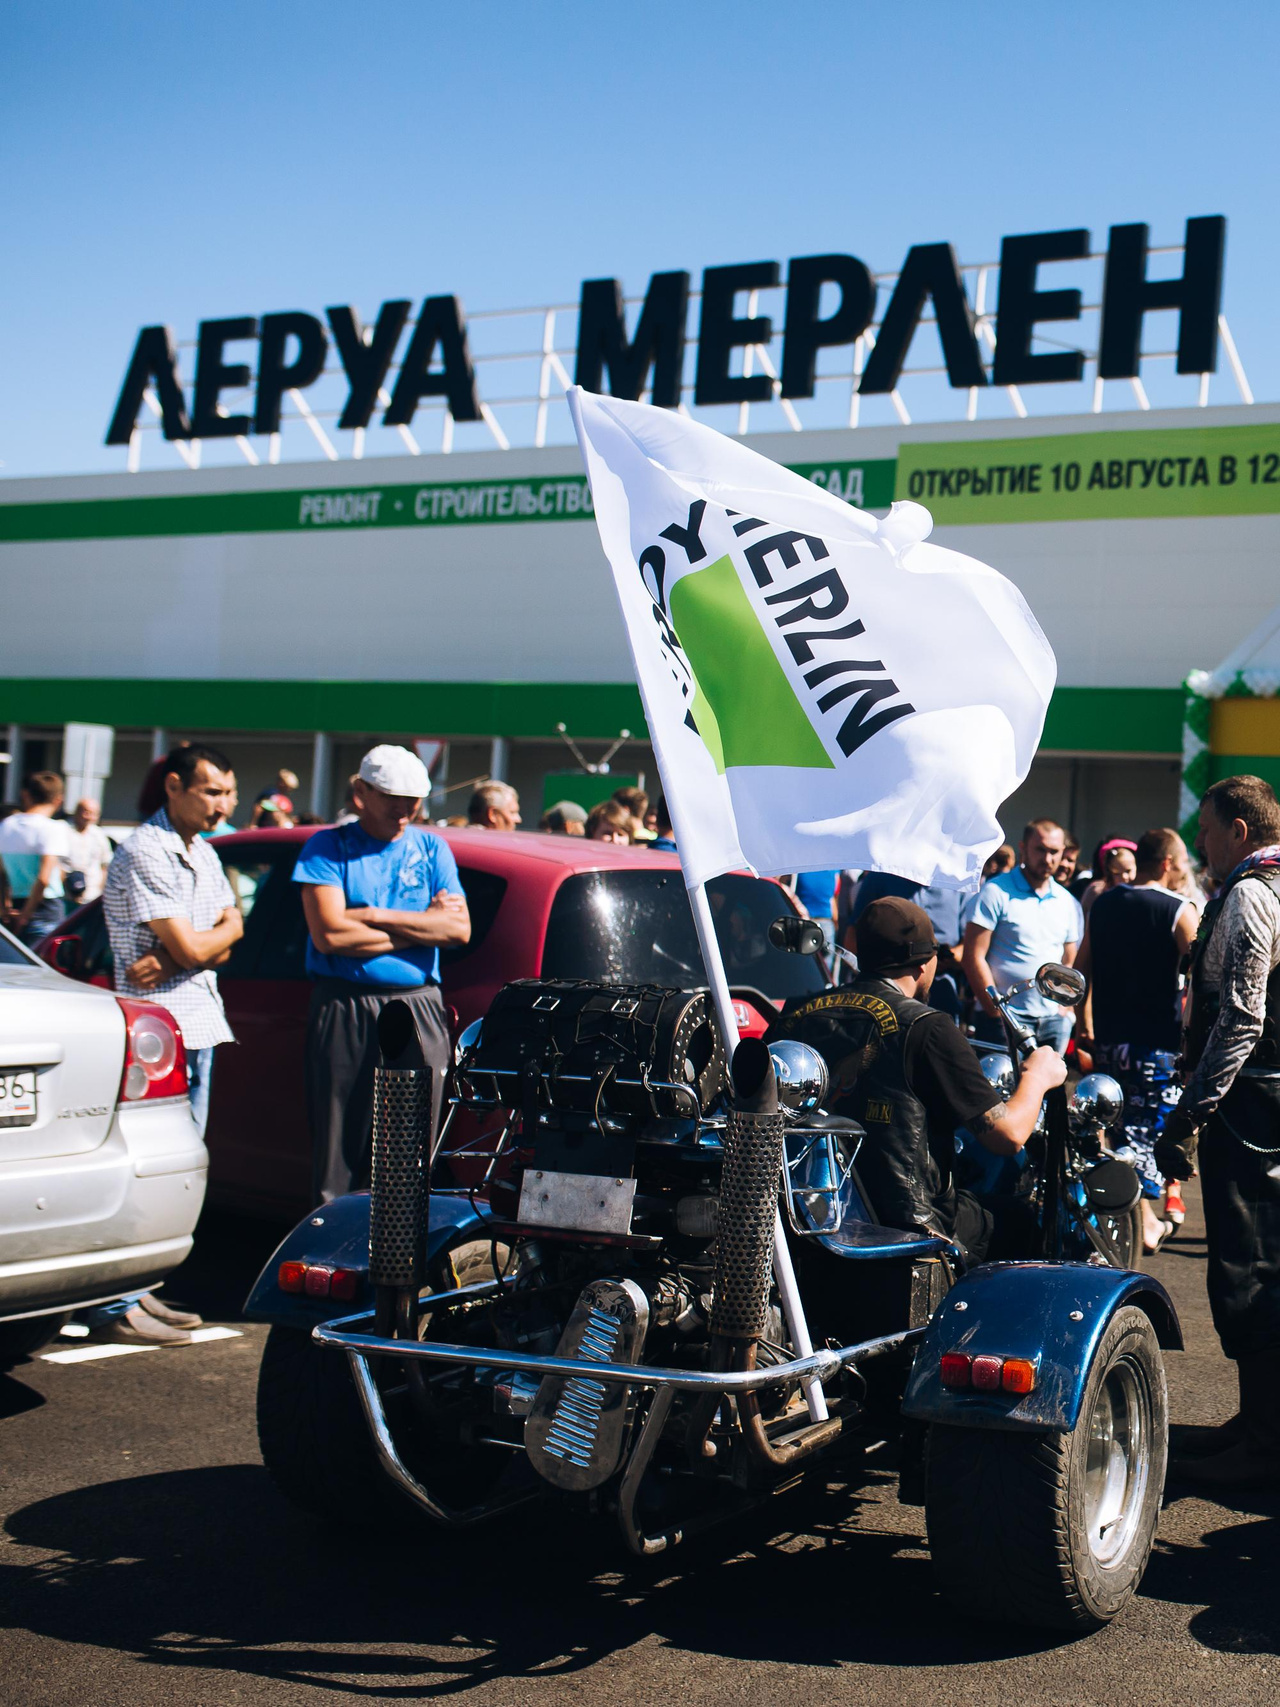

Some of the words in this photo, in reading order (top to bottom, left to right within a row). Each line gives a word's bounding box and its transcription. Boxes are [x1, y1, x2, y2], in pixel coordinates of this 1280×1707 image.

[104, 294, 484, 446] ЛЕРУА
[575, 214, 1227, 408] МЕРЛЕН
[908, 463, 1042, 499] ОТКРЫТИЕ
[1052, 461, 1081, 492] 10
[1087, 456, 1209, 491] АВГУСТА
[1218, 454, 1238, 486] В
[300, 491, 382, 525] РЕМОНТ
[415, 480, 593, 521] СТРОИТЕЛЬСТВО
